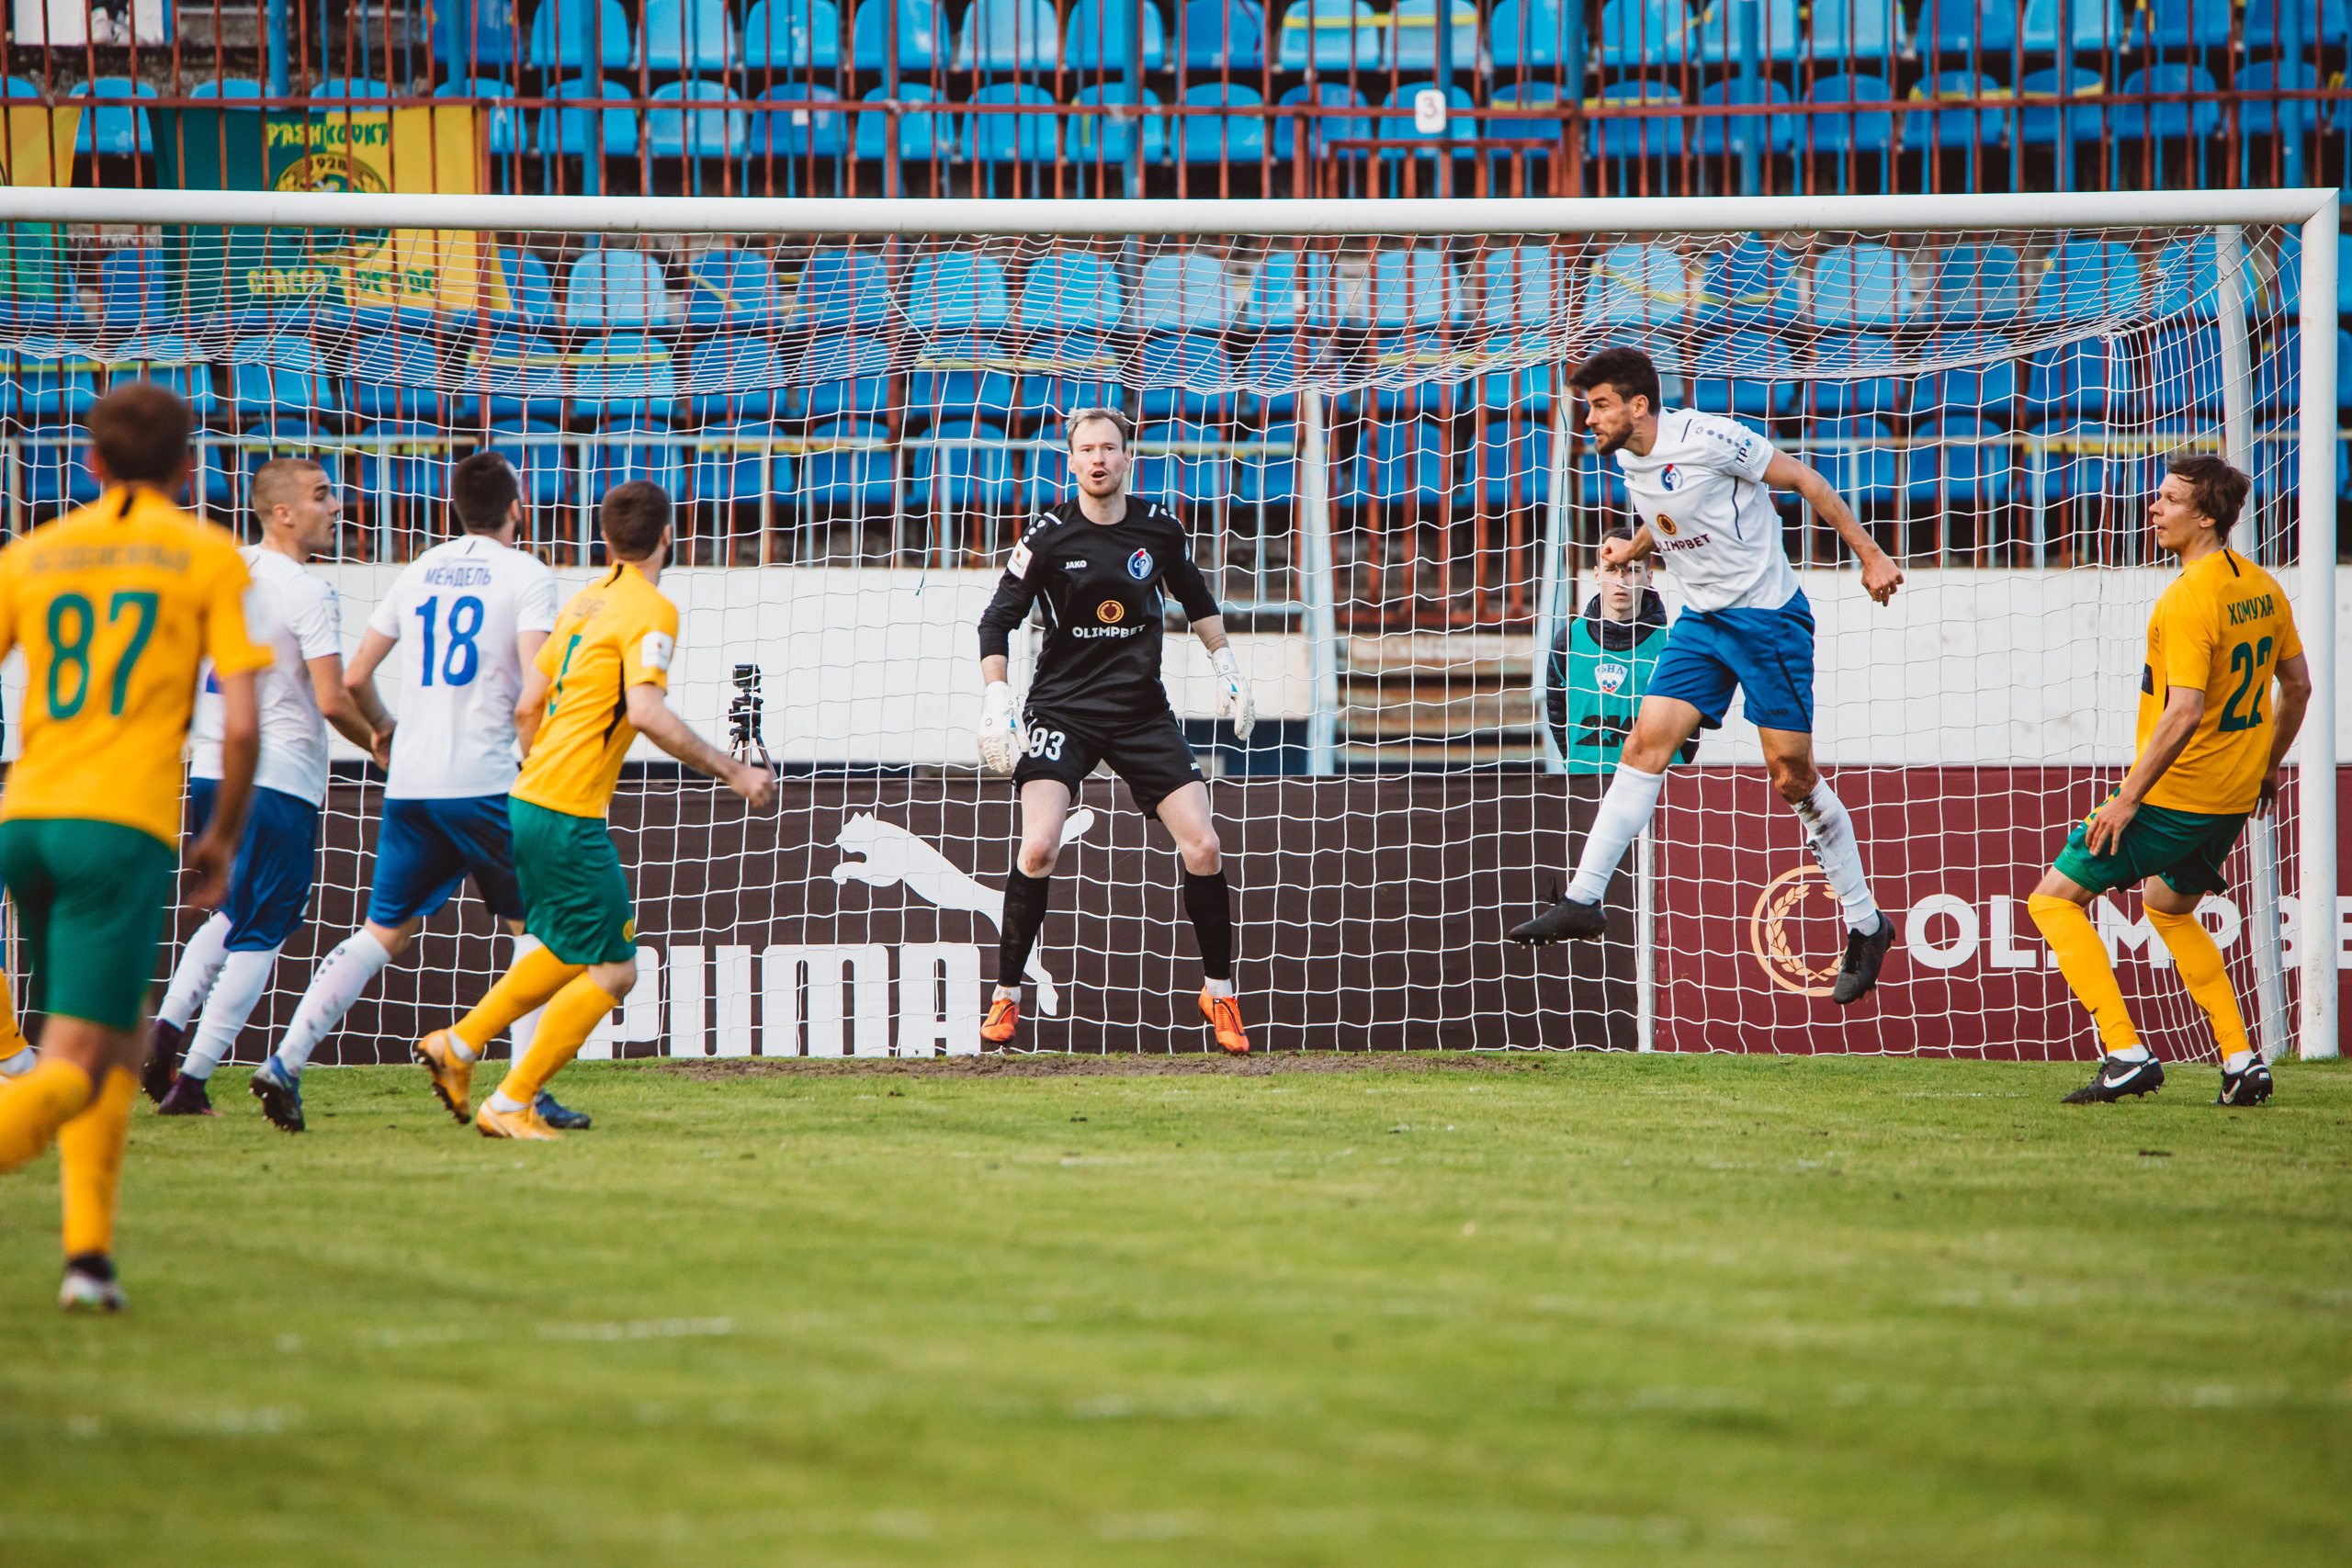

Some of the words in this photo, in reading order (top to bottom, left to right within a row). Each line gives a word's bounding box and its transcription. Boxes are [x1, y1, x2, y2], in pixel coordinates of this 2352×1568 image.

[1422, 96, 1438, 118] 3
[1657, 534, 1711, 552] LIMPBET
[424, 567, 492, 587] МЕНДЕЛЬ
[1065, 559, 1087, 570] JAKO
[2227, 594, 2275, 626] ХОМУХА
[415, 595, 483, 686] 18
[1072, 625, 1146, 638] OLIMPBET
[49, 592, 158, 719] 87
[2218, 636, 2273, 731] 22
[1028, 728, 1066, 761] 93
[577, 943, 981, 1060] PUMA
